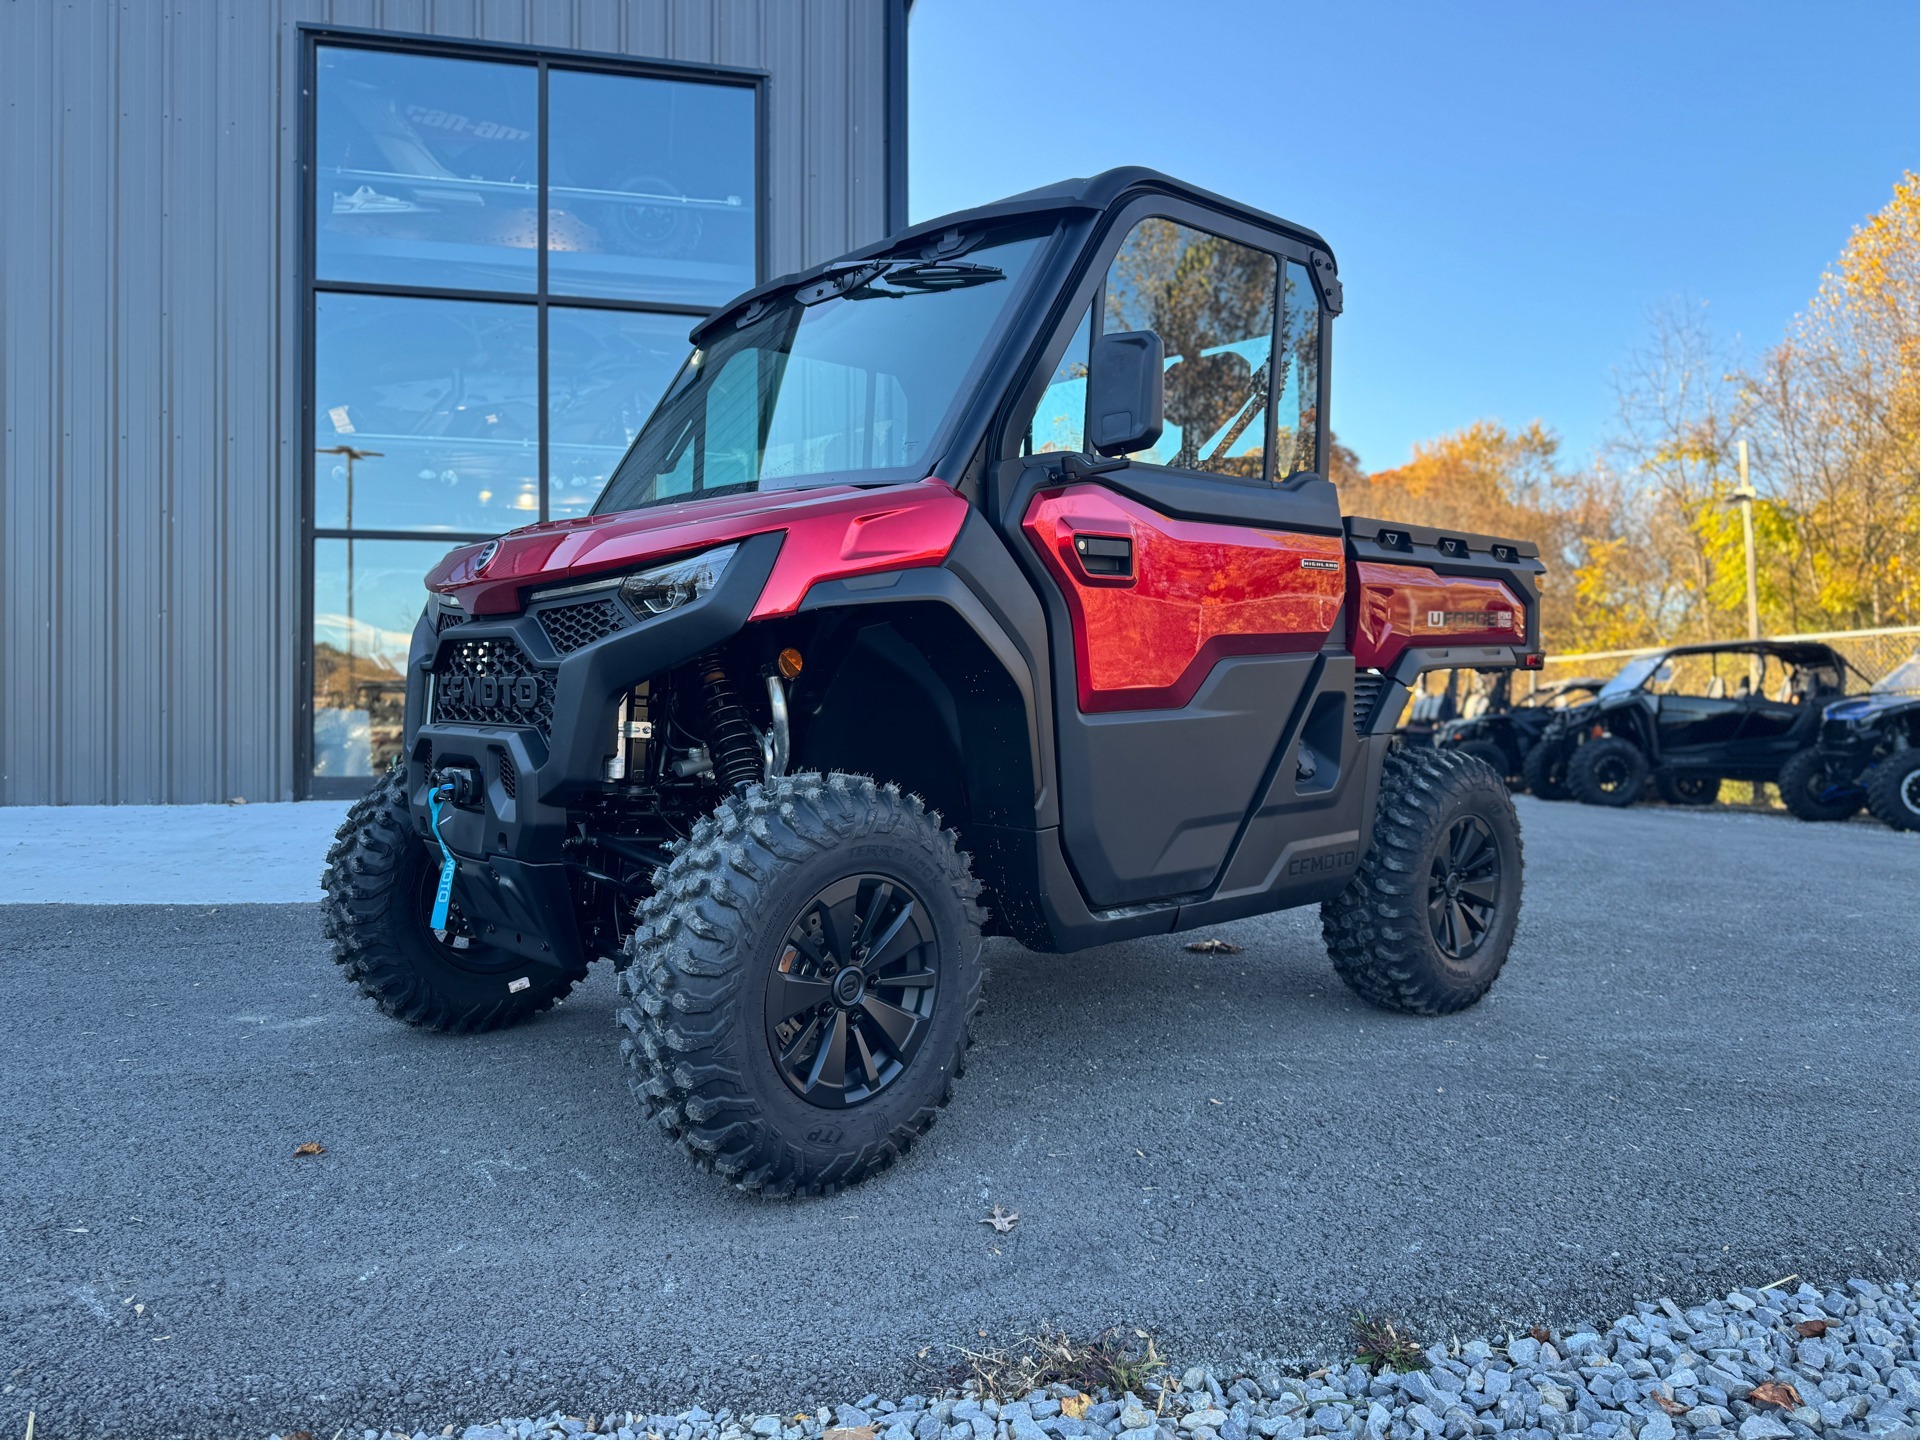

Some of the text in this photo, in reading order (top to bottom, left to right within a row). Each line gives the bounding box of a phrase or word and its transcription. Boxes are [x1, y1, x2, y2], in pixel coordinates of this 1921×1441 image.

[405, 104, 530, 135] can-am
[1304, 561, 1338, 569] HIGHLAND
[439, 676, 538, 709] CFMOTO
[1288, 851, 1355, 877] CFMOTO
[806, 1128, 844, 1145] ITP
